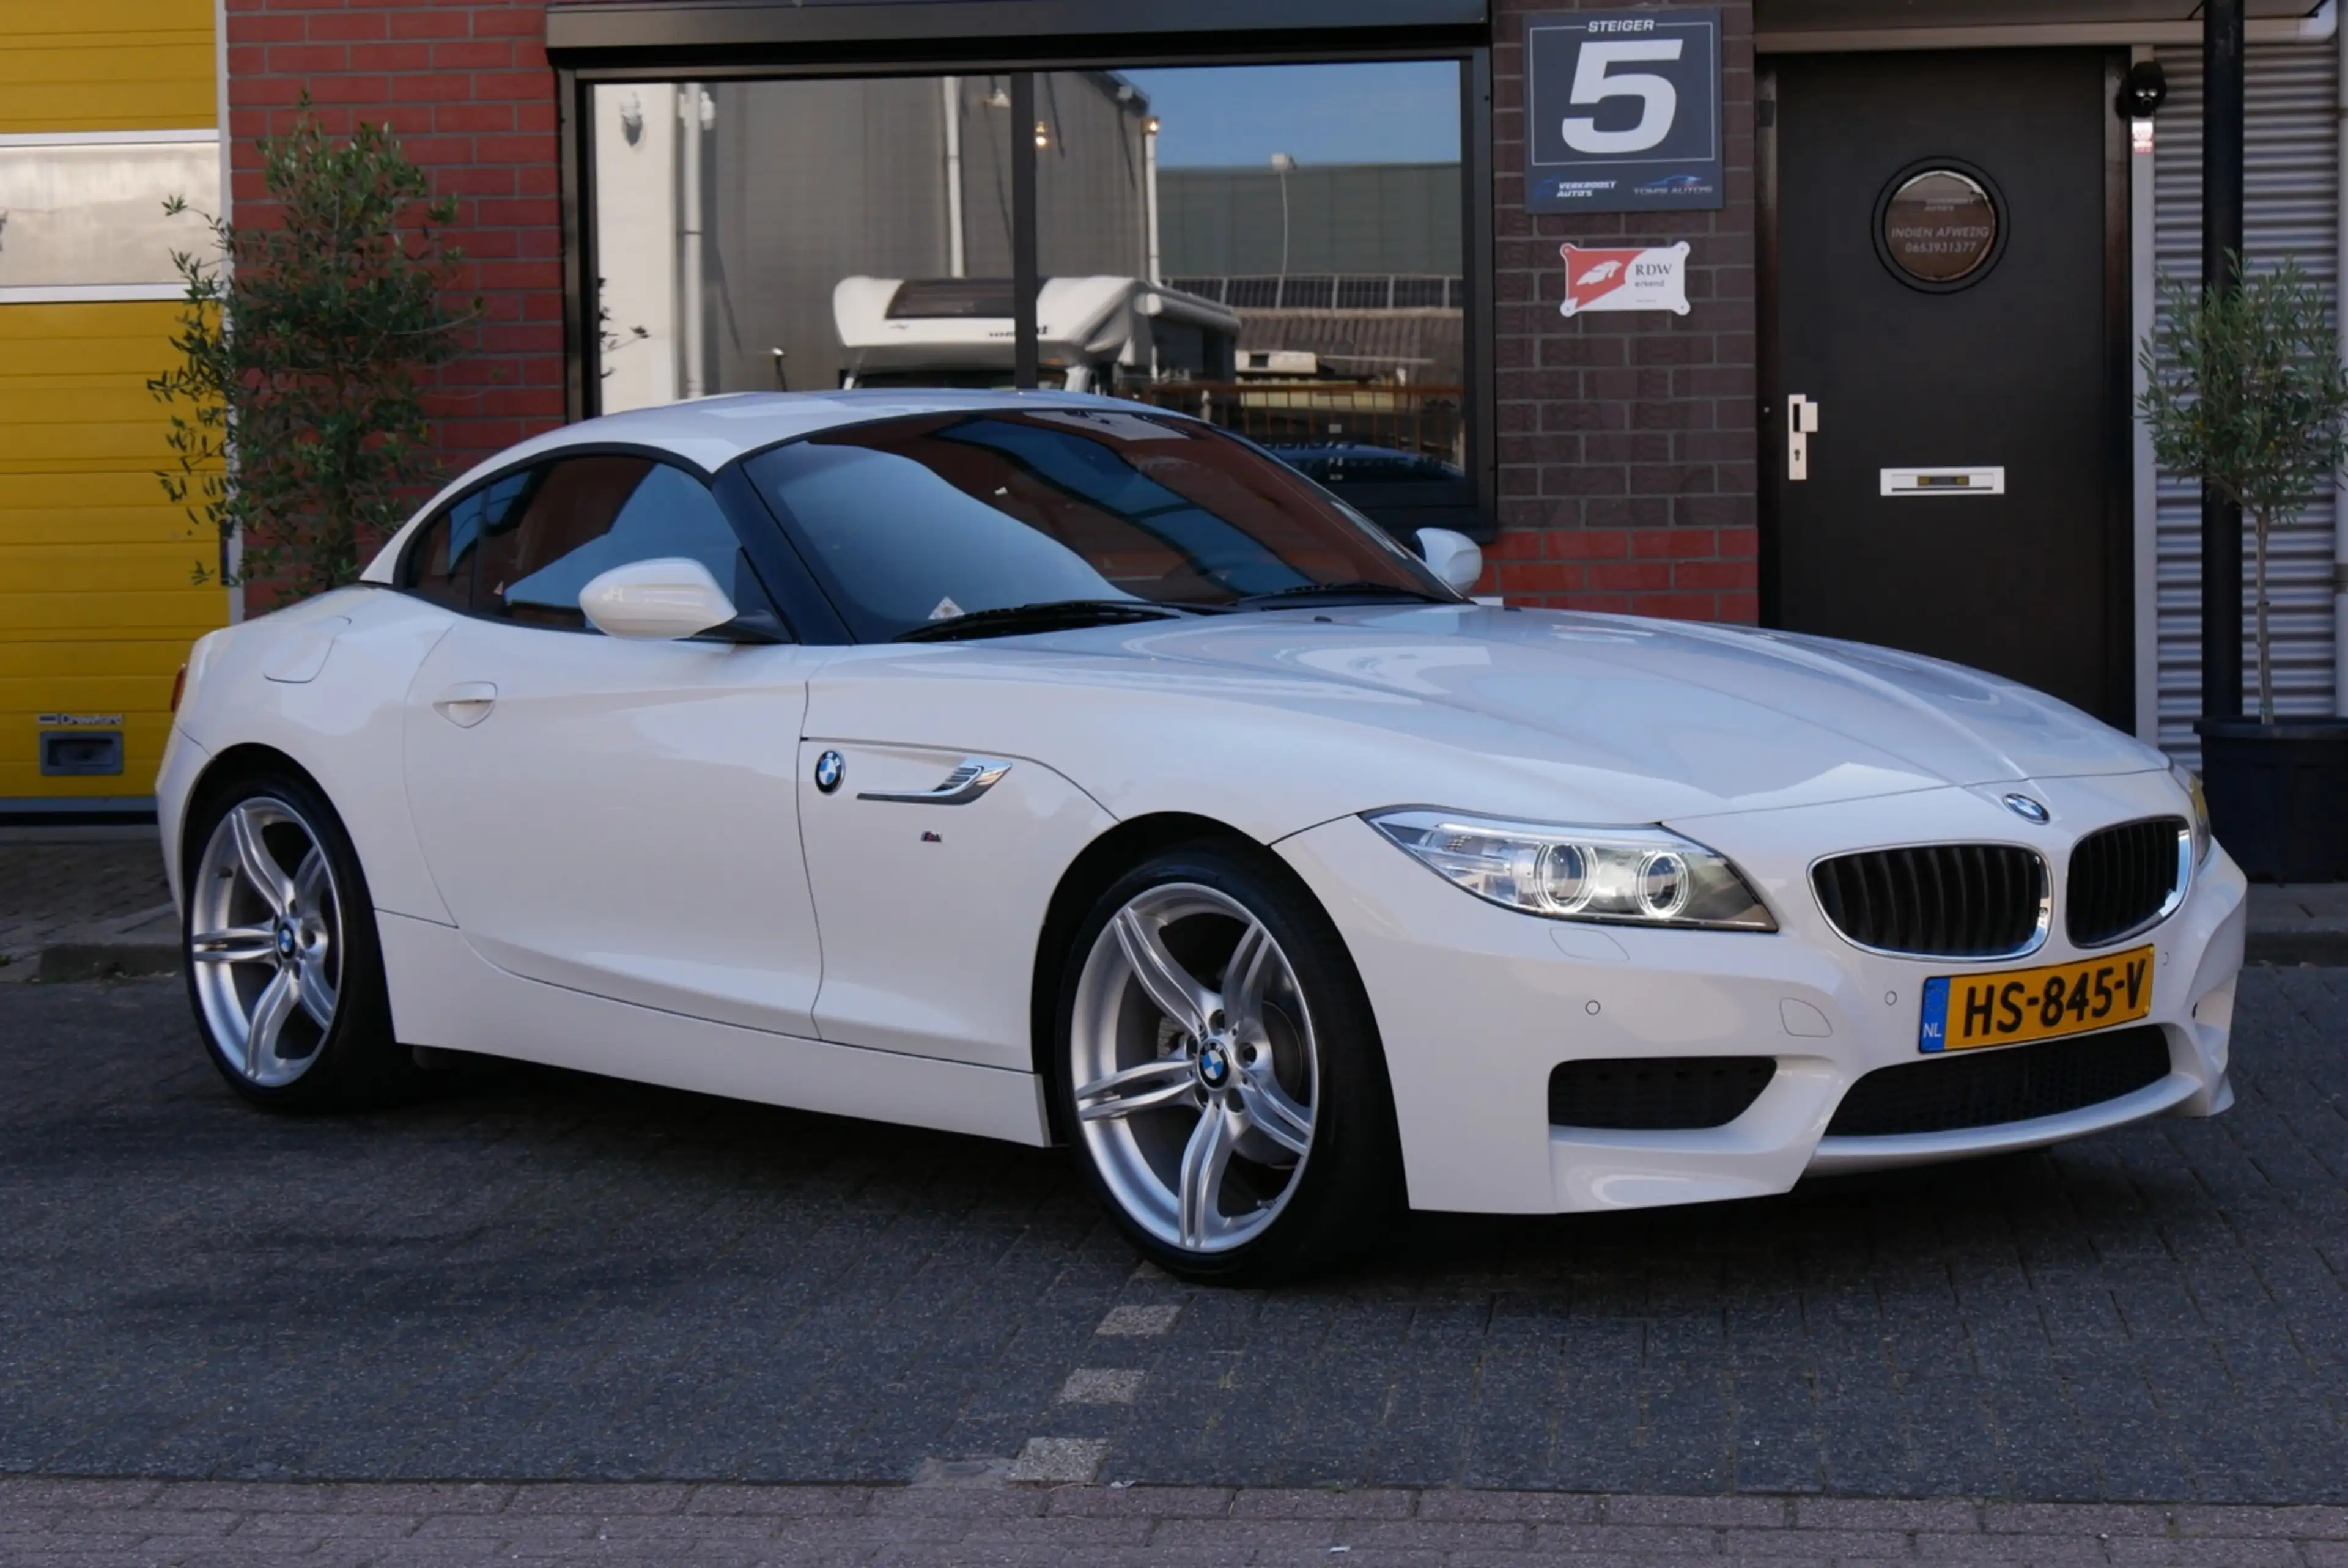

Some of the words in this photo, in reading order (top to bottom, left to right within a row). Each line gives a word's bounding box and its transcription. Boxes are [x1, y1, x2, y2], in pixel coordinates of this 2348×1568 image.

[1588, 20, 1655, 32] STEIGER
[1562, 39, 1683, 153] 5
[1891, 227, 1933, 238] INDIEN
[1936, 226, 1989, 238] AFWEZIG
[1635, 263, 1672, 276] RDW
[1963, 959, 2146, 1037] HS-845-V
[1923, 1023, 1941, 1038] NL
